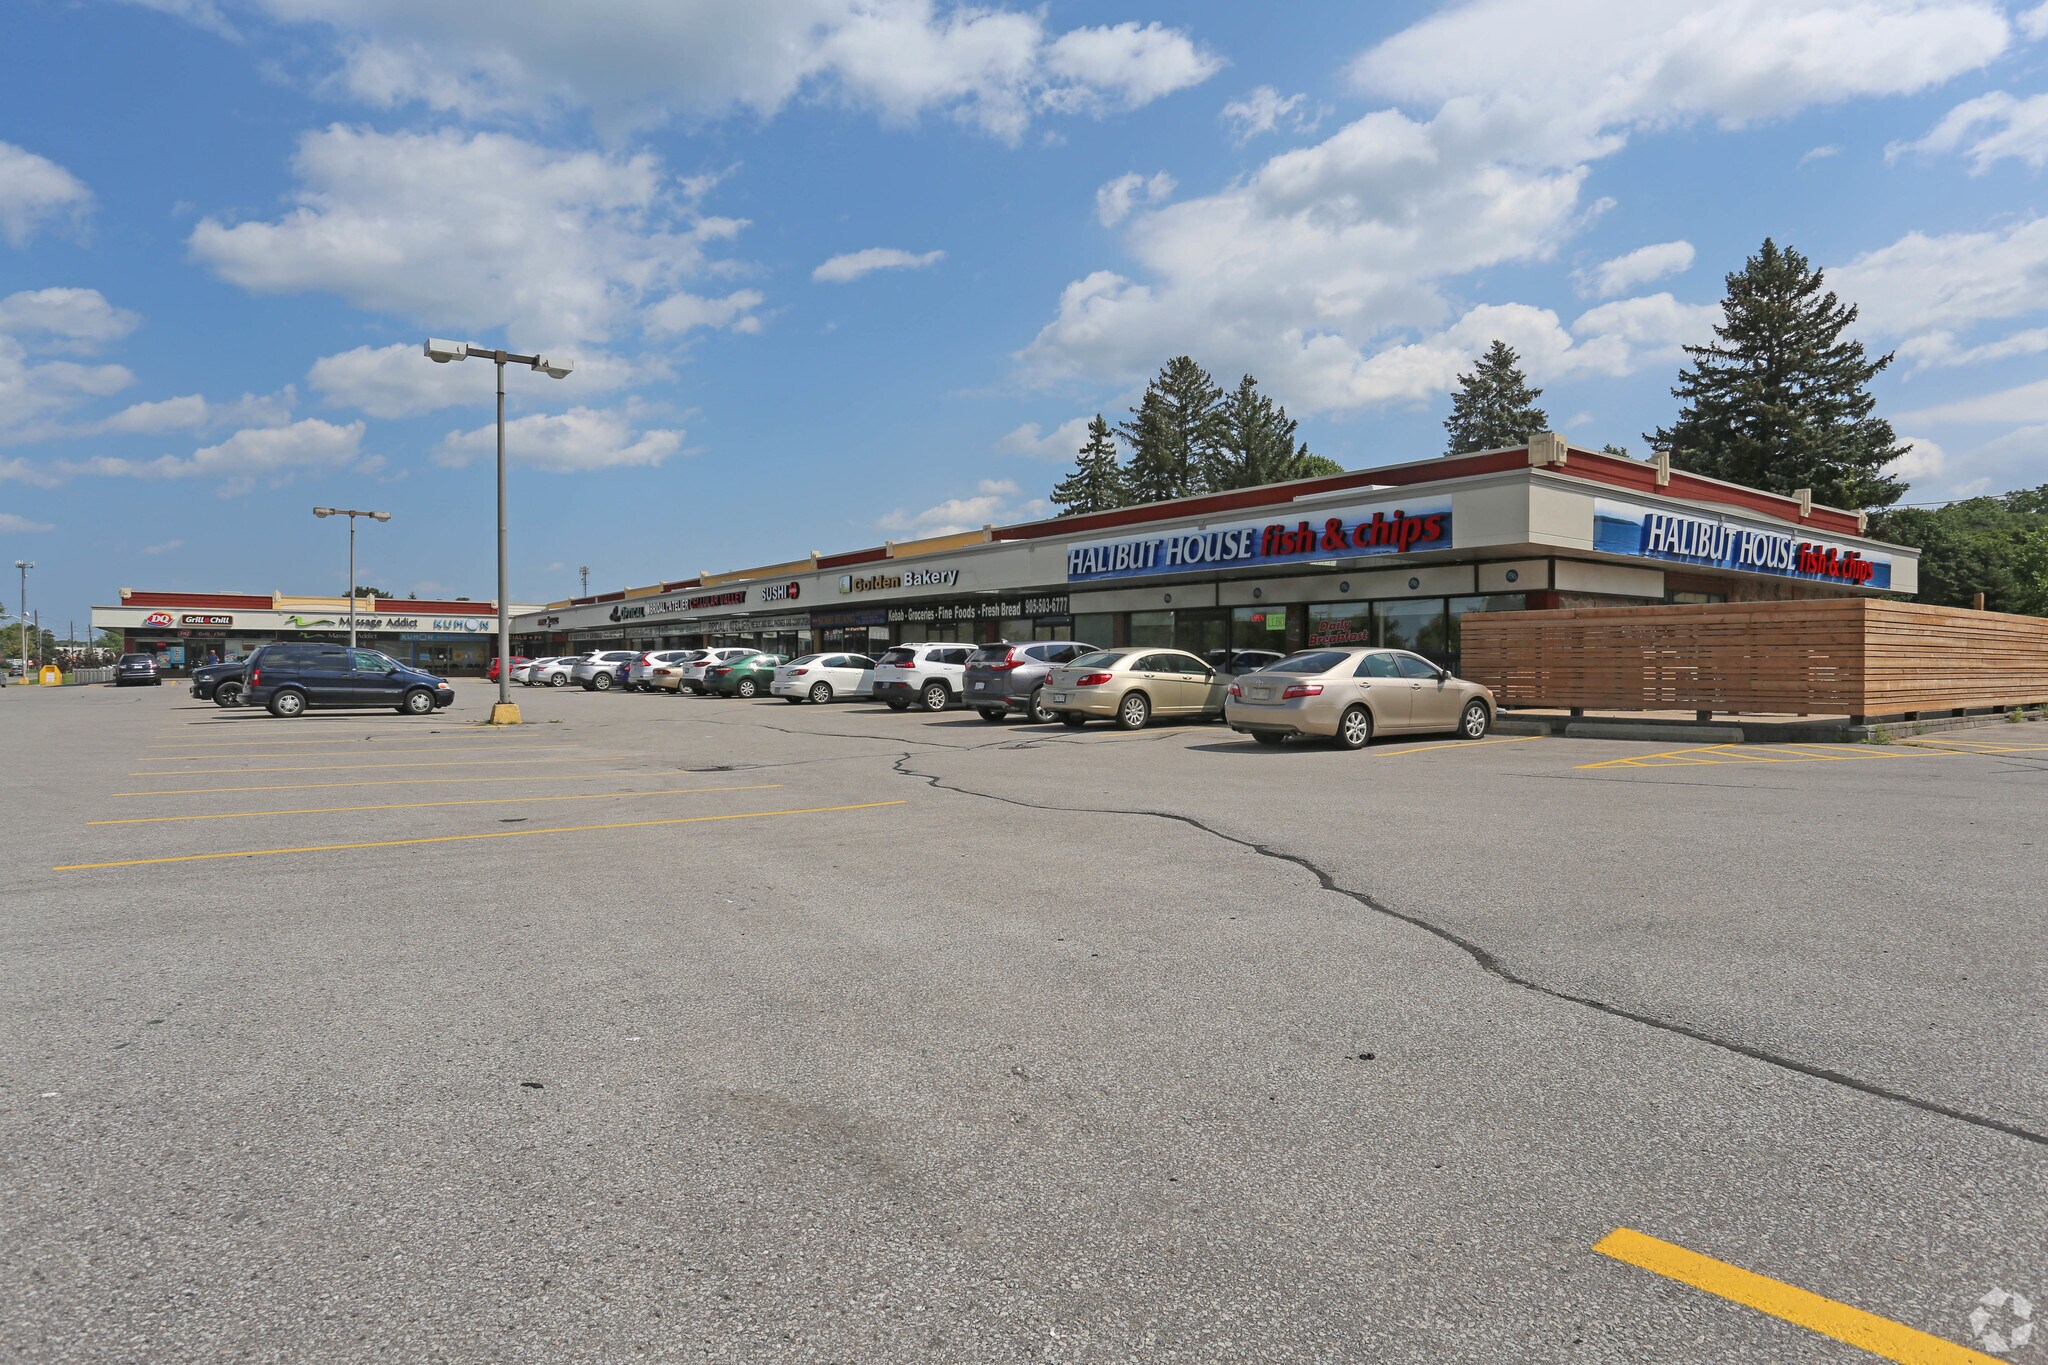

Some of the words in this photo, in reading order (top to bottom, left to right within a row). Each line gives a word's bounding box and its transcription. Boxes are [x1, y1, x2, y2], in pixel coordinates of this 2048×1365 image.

[1068, 539, 1161, 575] HALIBUT
[1165, 528, 1254, 566] HOUSE
[1260, 520, 1315, 556] fish
[1320, 517, 1349, 551] &
[1352, 509, 1442, 553] chips
[1648, 513, 1737, 561] HALIBUT
[1739, 530, 1796, 571] HOUSE
[1799, 542, 1827, 574] fish
[1828, 547, 1840, 577] &
[1841, 550, 1874, 585] chips
[854, 575, 900, 592] Golden
[903, 569, 959, 587] Bakery
[761, 585, 787, 601] SUSHI
[620, 606, 645, 620] OPTICAL
[720, 591, 746, 605] VALLEY
[888, 609, 905, 622] Kebab
[908, 607, 934, 621] Groceries
[938, 606, 953, 620] Fine
[955, 605, 976, 619] Foods
[981, 603, 1000, 617] Fresh
[1001, 602, 1021, 616] Bread
[1025, 597, 1068, 614] 905-503-6777
[151, 614, 170, 623] DQ
[340, 617, 382, 628] Mssage
[386, 617, 418, 627] Addict
[433, 618, 489, 631] KUMON
[1319, 618, 1351, 633] Daily
[400, 633, 434, 641] KUMON
[1308, 629, 1369, 647] Breakfast
